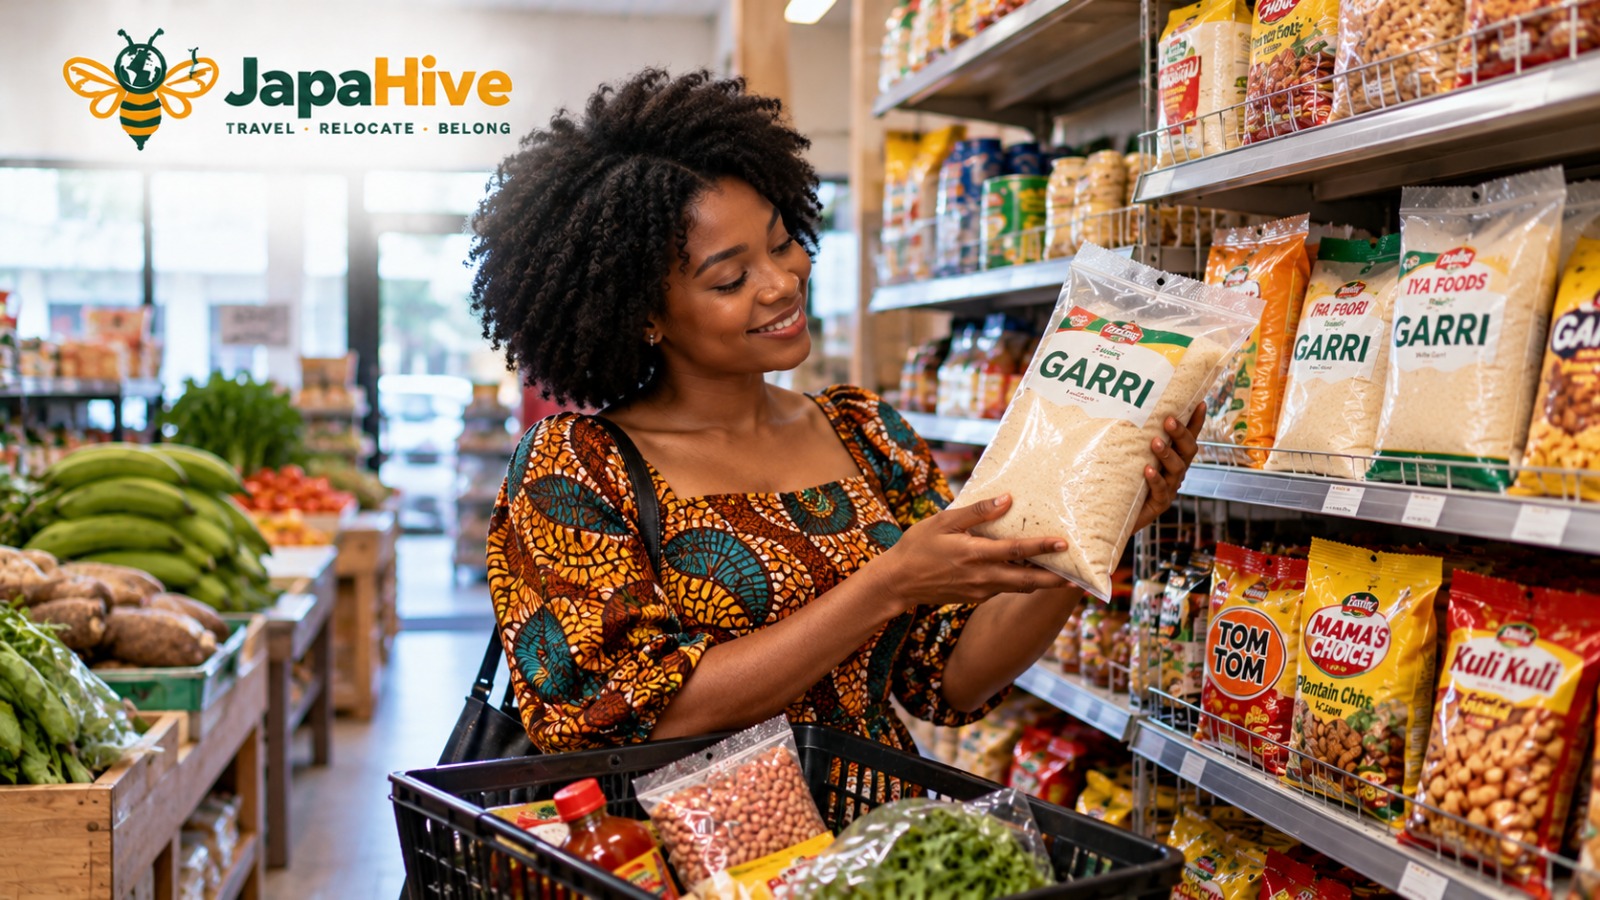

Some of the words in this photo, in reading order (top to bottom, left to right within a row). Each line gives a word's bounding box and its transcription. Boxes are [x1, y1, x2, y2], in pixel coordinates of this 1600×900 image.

[1406, 278, 1431, 296] IYA
[1433, 273, 1489, 293] FOODS
[1294, 333, 1372, 363] GARRI
[1395, 313, 1491, 348] GARRI
[1039, 350, 1155, 409] GARRI
[1217, 619, 1270, 657] TOM
[1310, 613, 1390, 649] MAMA'S
[1213, 646, 1266, 687] TOM
[1310, 640, 1375, 668] CHOICE
[1450, 645, 1504, 680] Kuli
[1501, 657, 1562, 693] Kuli
[1296, 674, 1340, 703] Plantain
